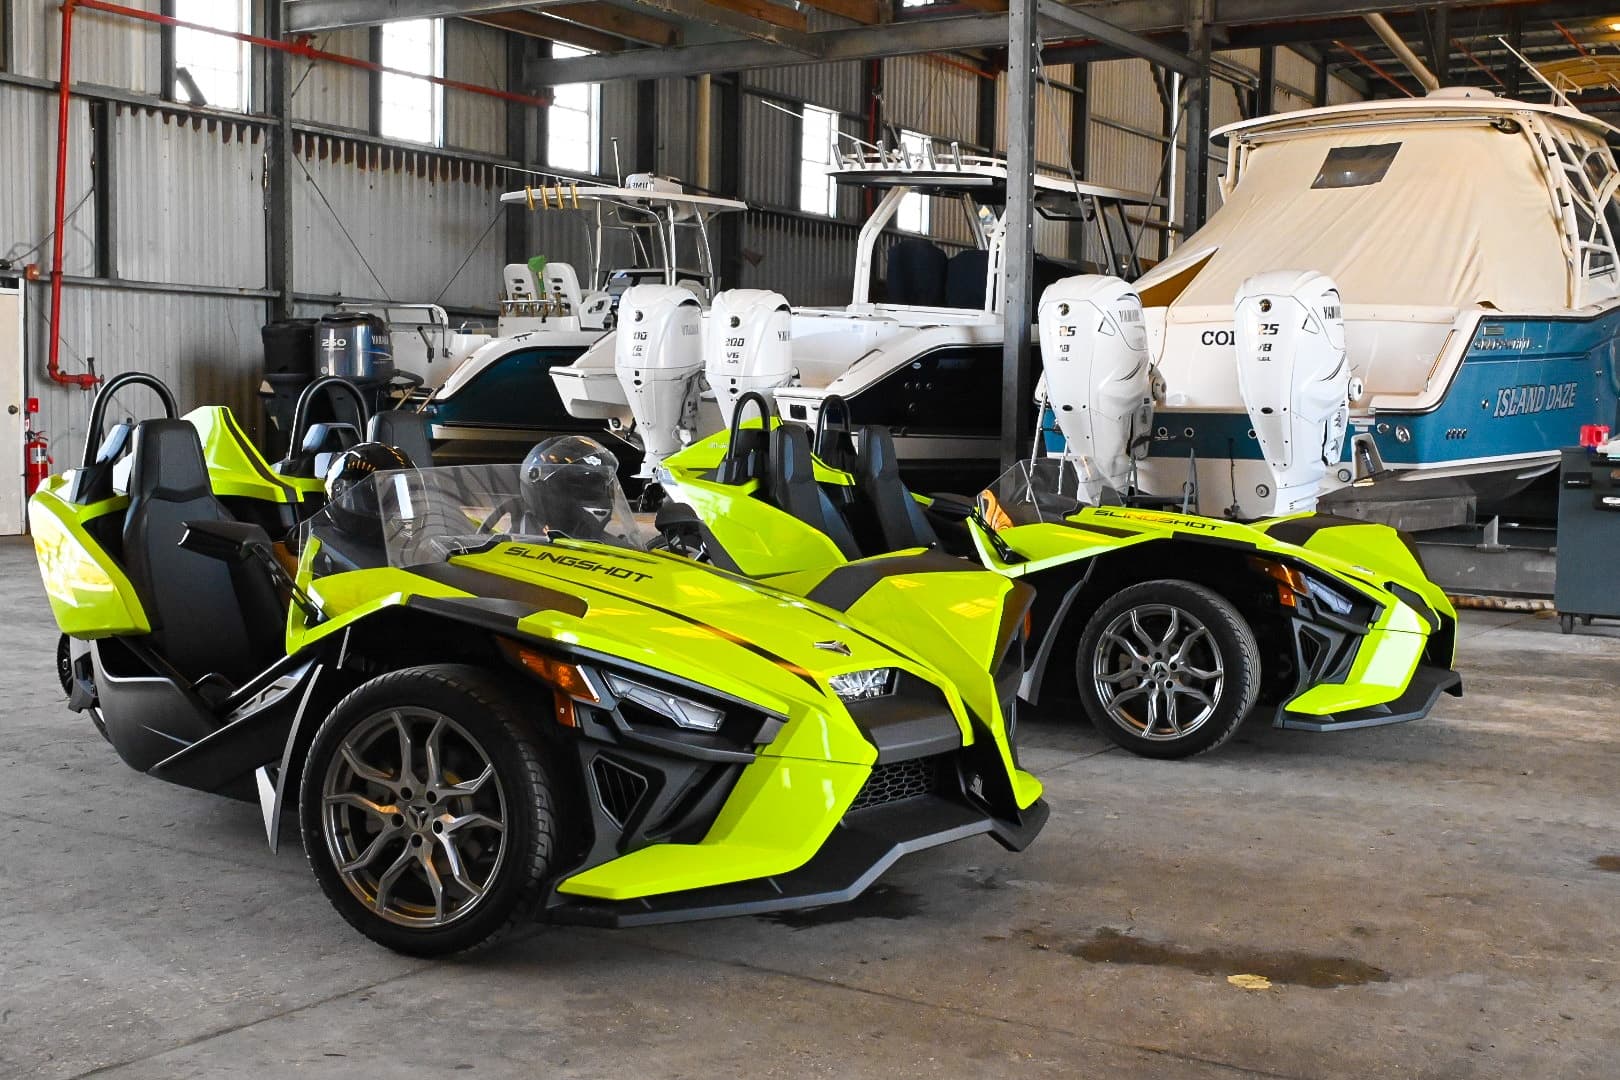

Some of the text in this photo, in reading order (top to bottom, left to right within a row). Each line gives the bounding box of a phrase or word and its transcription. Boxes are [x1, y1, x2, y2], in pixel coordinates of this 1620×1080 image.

[1258, 323, 1280, 336] 25
[1493, 381, 1578, 418] ISLAND DAZE
[1093, 508, 1222, 531] SLINGSHOT
[503, 545, 653, 583] SLINGSHOT
